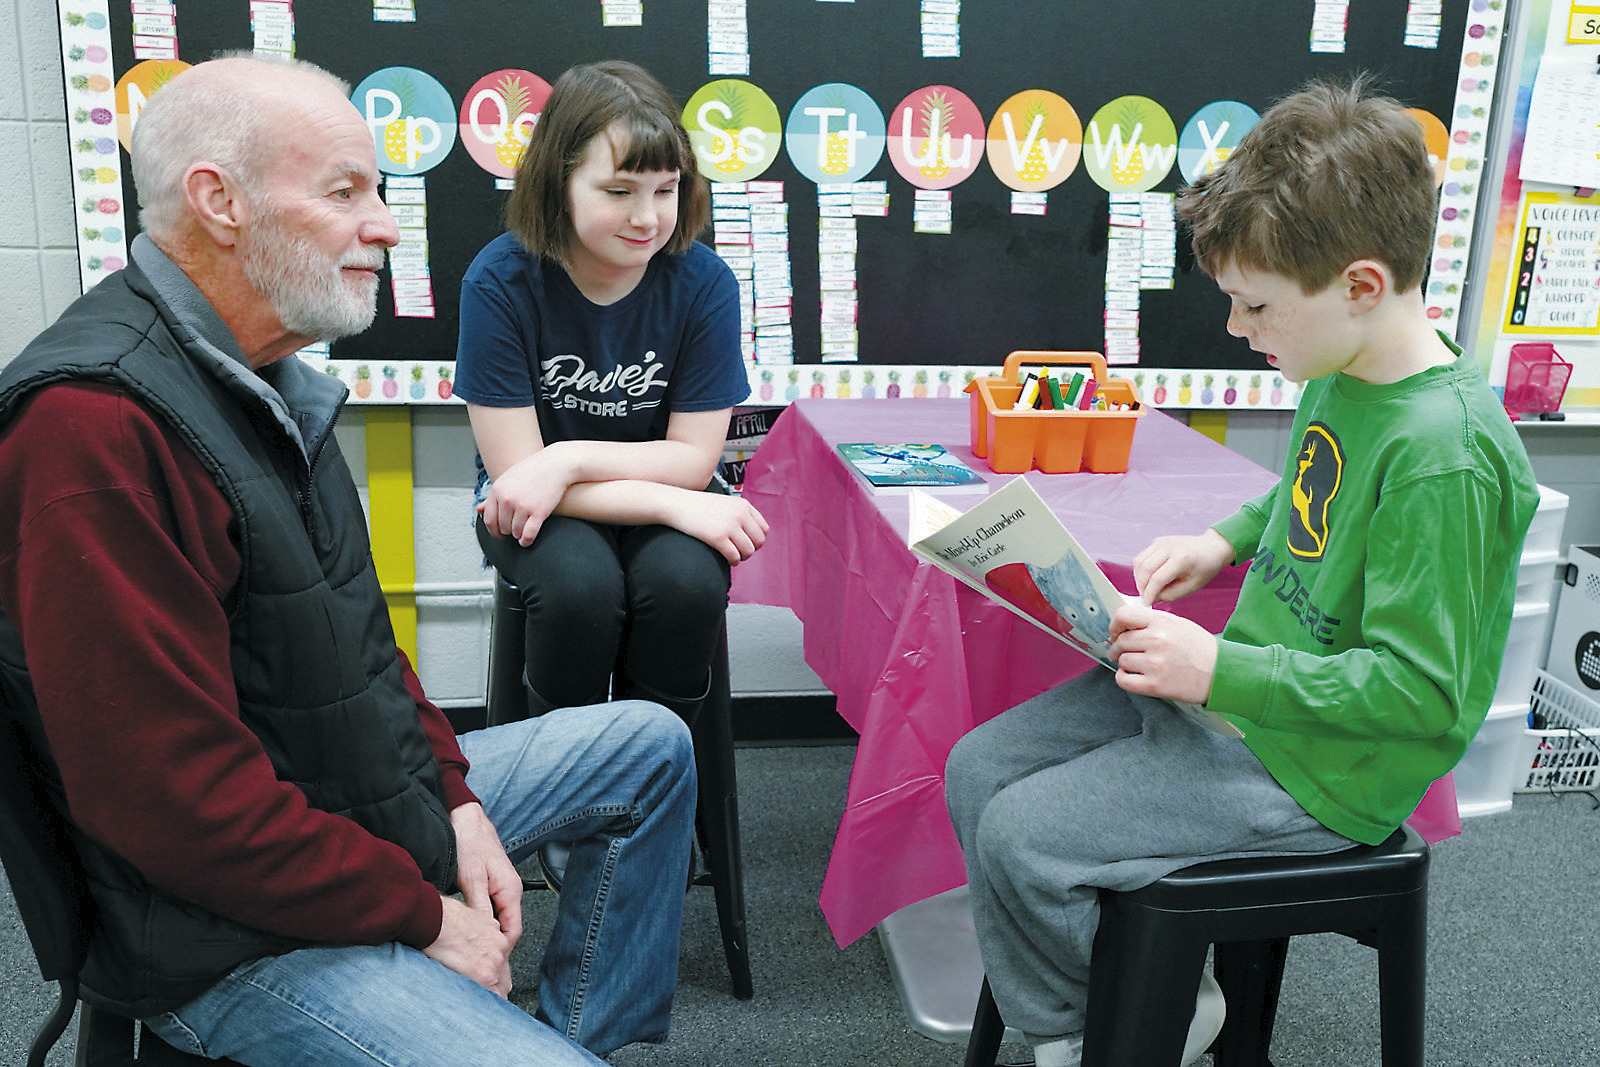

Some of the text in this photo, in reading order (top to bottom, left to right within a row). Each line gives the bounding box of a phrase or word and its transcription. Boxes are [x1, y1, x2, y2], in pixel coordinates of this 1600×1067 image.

[141, 24, 170, 33] answer
[264, 38, 283, 48] body
[366, 88, 442, 169] Pp
[697, 100, 767, 164] Ss
[804, 106, 867, 167] Tt
[902, 106, 972, 169] Uu
[1002, 112, 1069, 172] Vv
[1090, 120, 1176, 171] Ww
[1192, 119, 1237, 177] X
[400, 206, 414, 215] pull
[1527, 228, 1538, 244] 4
[1524, 247, 1535, 262] 3
[1520, 272, 1531, 287] 2
[1520, 291, 1527, 306] 1
[1513, 309, 1524, 323] 0
[541, 350, 668, 398] Dave's
[564, 393, 628, 417] STORE
[736, 413, 769, 436] APRIL
[944, 535, 981, 558] Mixed-Up
[976, 508, 1026, 541] Chameleon
[974, 552, 989, 564] Eric
[987, 543, 1007, 557] Carle
